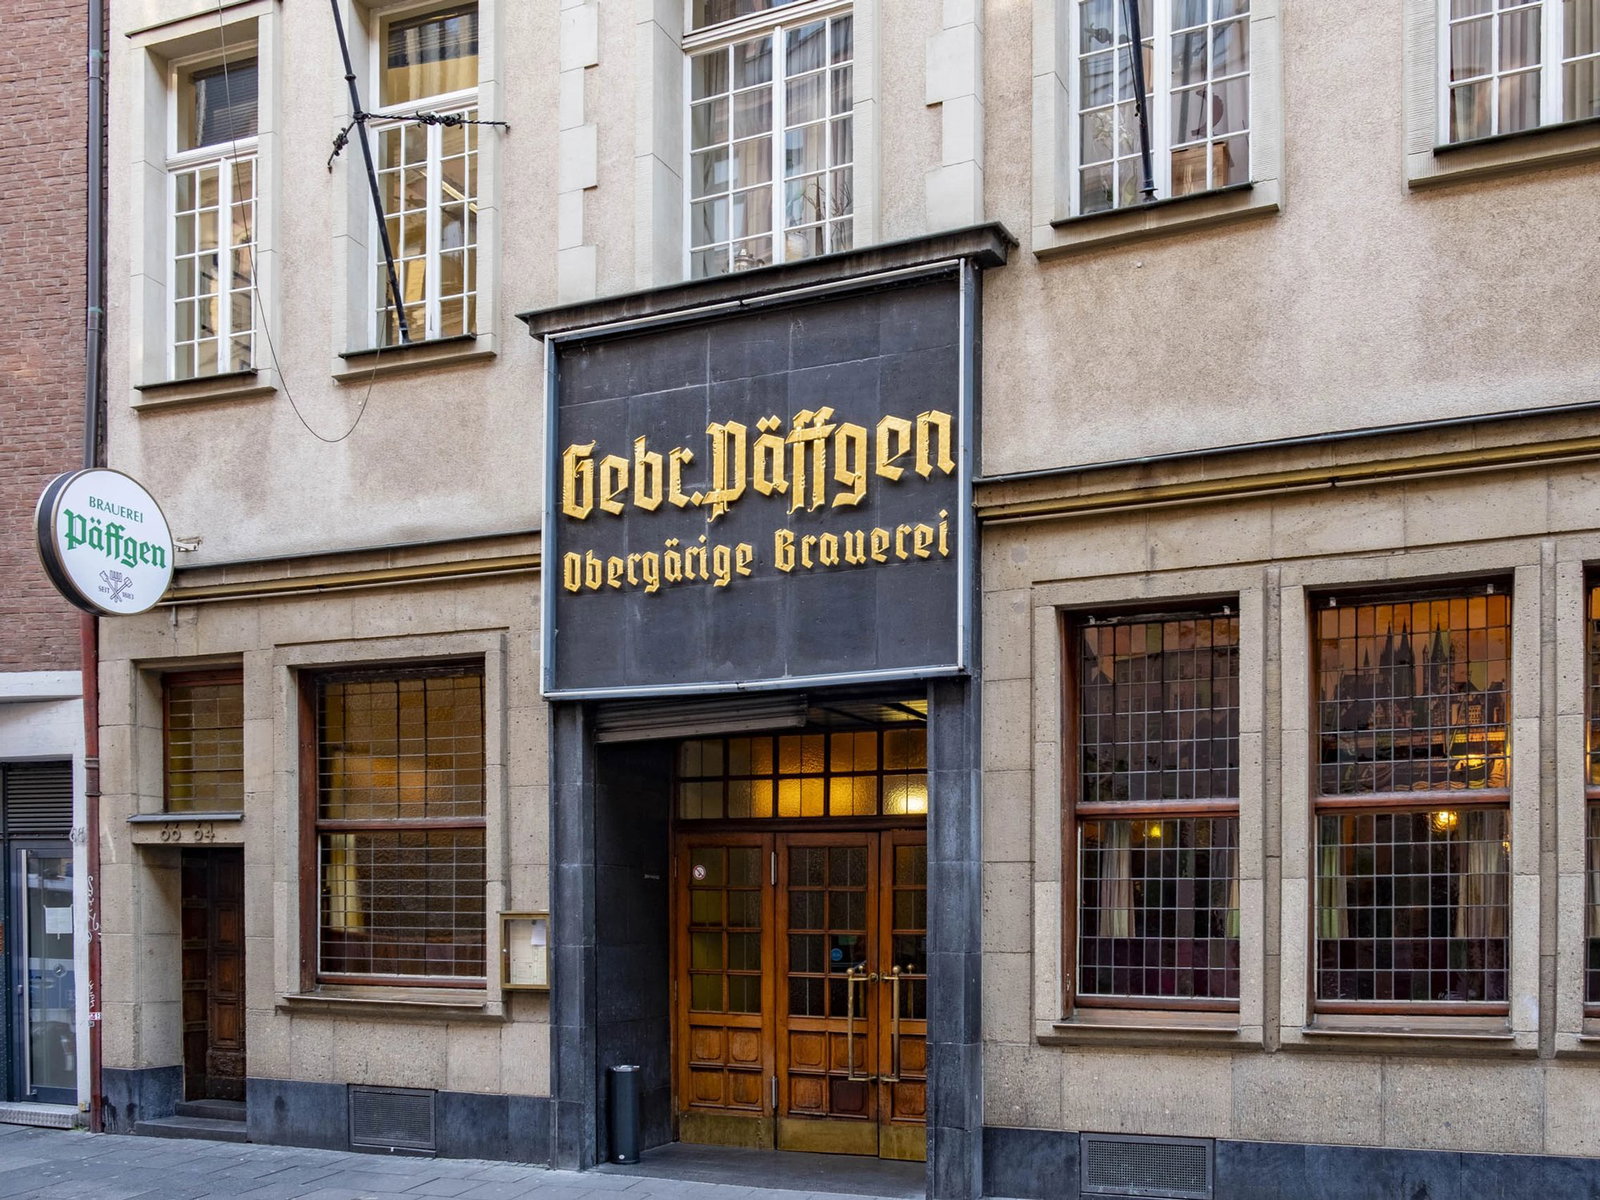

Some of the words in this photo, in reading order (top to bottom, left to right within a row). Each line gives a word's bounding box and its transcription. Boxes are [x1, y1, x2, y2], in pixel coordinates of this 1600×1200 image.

[563, 434, 704, 520] Gebr.
[701, 406, 956, 523] Päffgen
[63, 508, 167, 569] Päffgen
[89, 495, 144, 524] BRAUEREI
[563, 534, 754, 594] Obergärige
[774, 508, 950, 573] Brauerei
[160, 823, 182, 842] 66
[194, 823, 216, 842] 64
